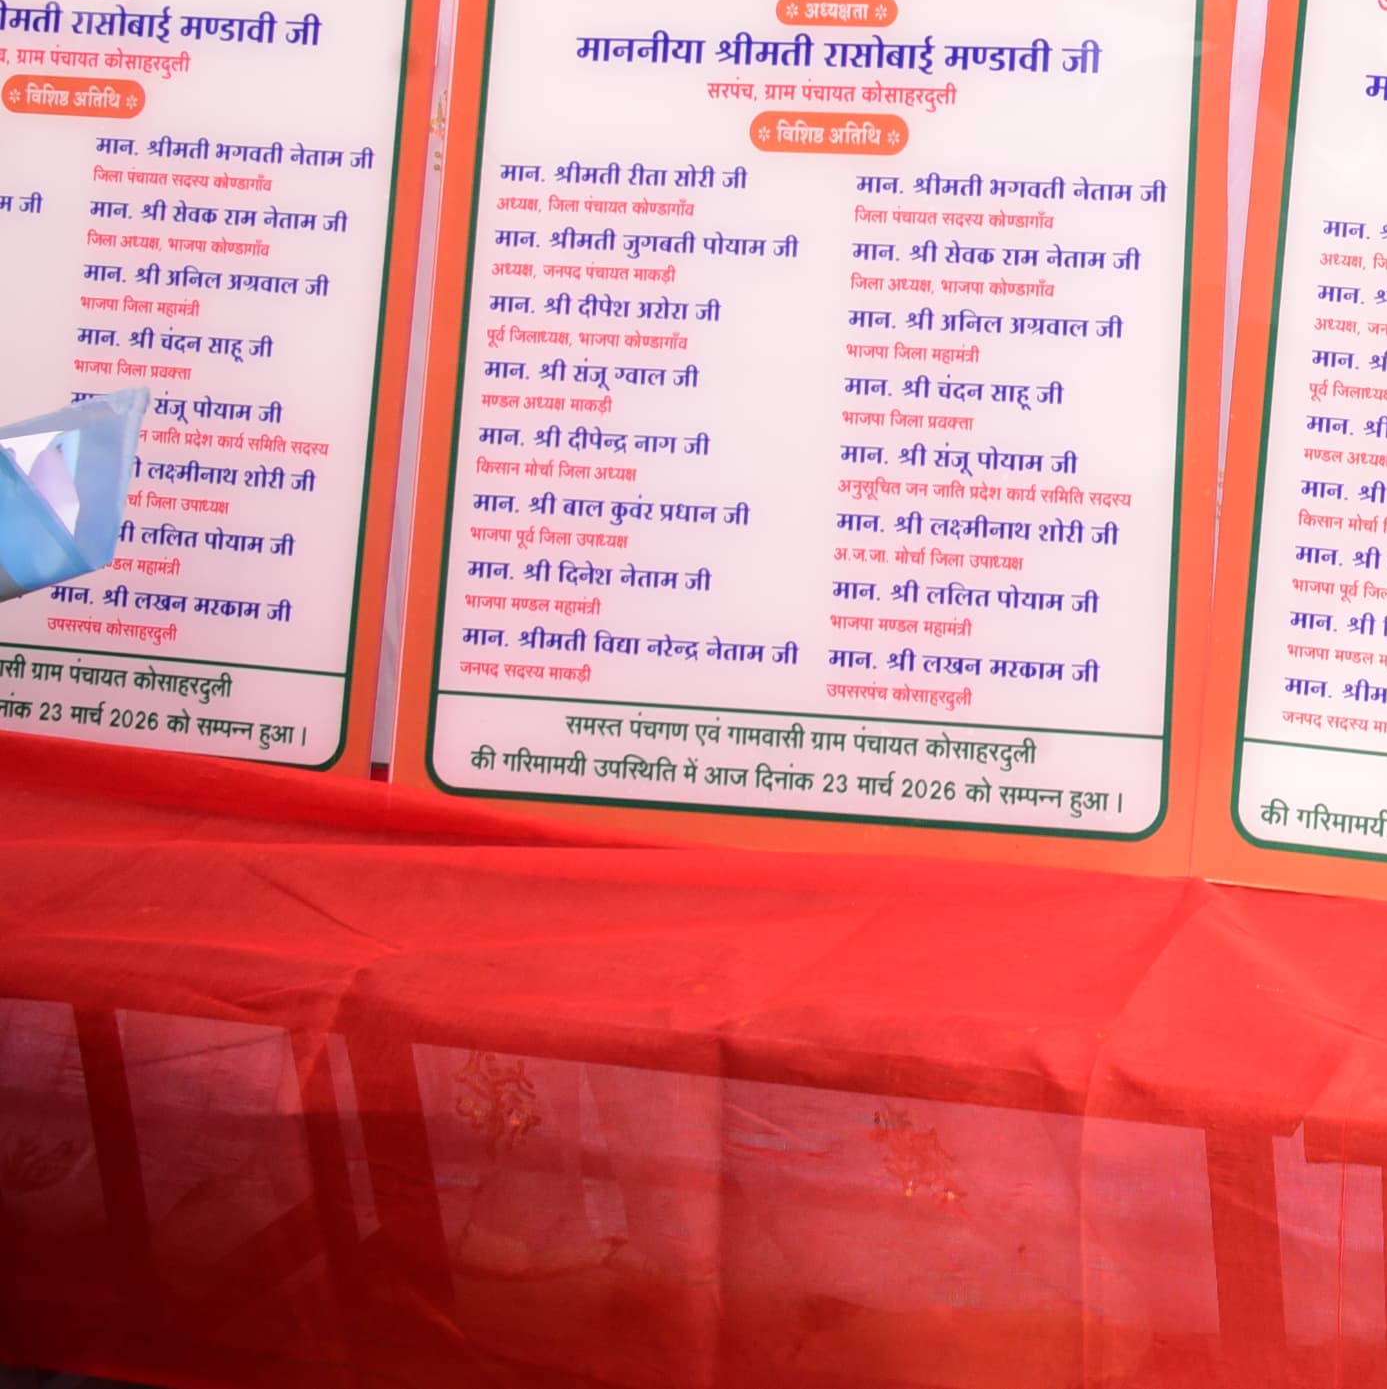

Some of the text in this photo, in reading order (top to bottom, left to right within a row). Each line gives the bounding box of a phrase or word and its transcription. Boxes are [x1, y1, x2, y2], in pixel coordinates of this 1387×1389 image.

[71, 4, 322, 45] रासोबाई मण्डावी जी
[576, 29, 1102, 75] माननीया श्रीमती रासोबाई मण्डावी जी
[706, 76, 757, 101] सरपंच,
[801, 78, 856, 102] पंचायत
[861, 80, 957, 113] कोसाहरदुली
[549, 226, 616, 250] श्रीमती
[703, 231, 766, 256] पोयाम
[773, 234, 798, 257] जी
[102, 584, 129, 608] श्री
[194, 597, 261, 619] मरकाम
[267, 599, 292, 622] जी
[106, 618, 177, 645] कोसाहरदुली
